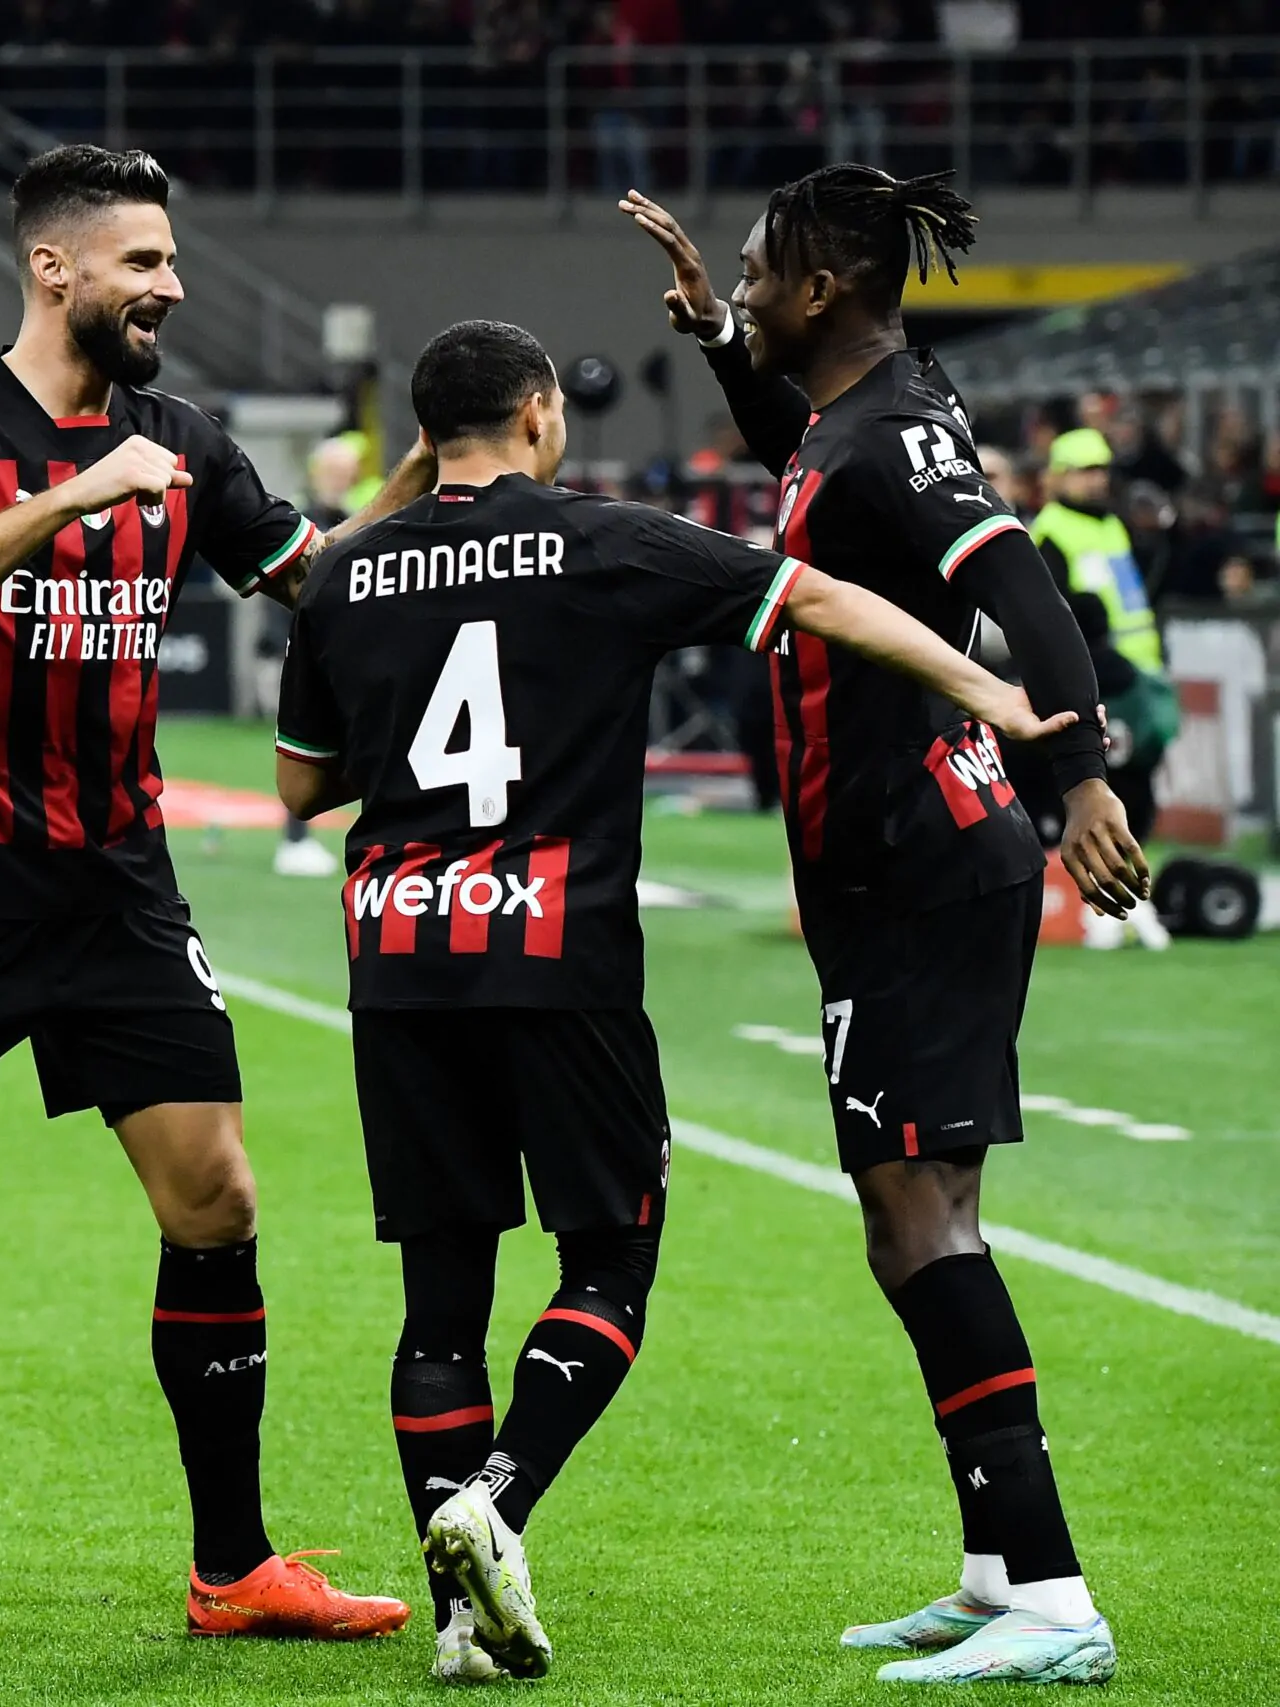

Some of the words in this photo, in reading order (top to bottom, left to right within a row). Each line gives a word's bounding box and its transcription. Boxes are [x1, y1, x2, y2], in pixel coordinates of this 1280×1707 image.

[909, 459, 978, 493] BitMEX
[1, 569, 172, 616] Emirates
[349, 532, 565, 603] BENNACER
[29, 623, 74, 660] FLY
[80, 623, 157, 660] BETTER
[407, 620, 522, 827] 4
[354, 860, 545, 921] wefox
[187, 936, 226, 1011] 9
[821, 999, 853, 1084] 7
[203, 1350, 267, 1377] ACM
